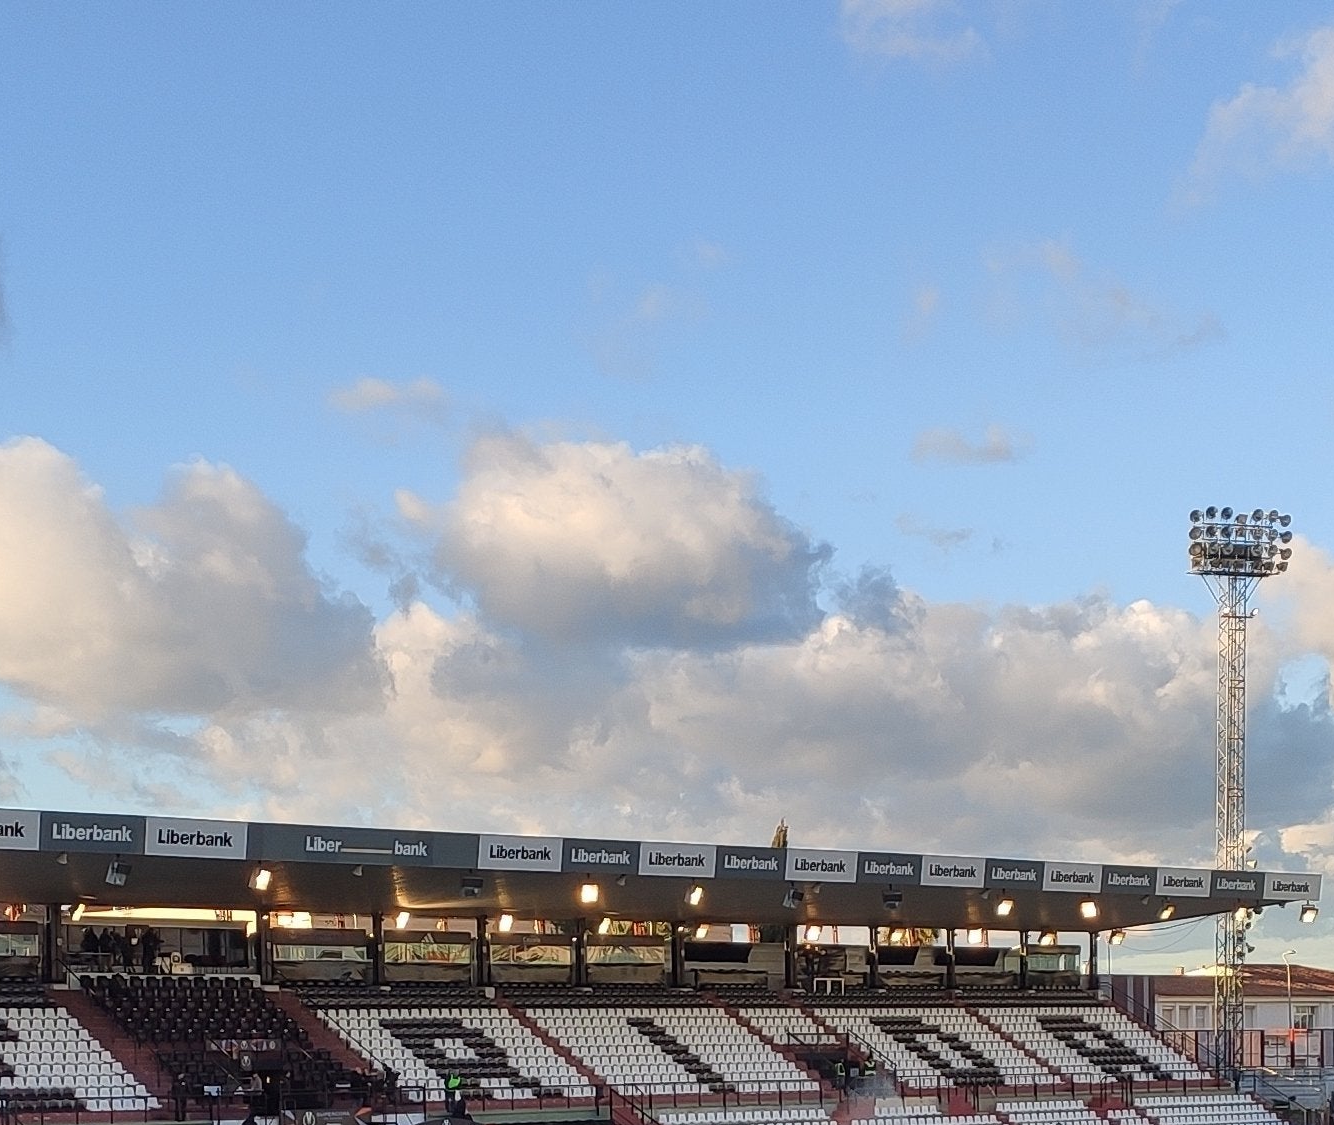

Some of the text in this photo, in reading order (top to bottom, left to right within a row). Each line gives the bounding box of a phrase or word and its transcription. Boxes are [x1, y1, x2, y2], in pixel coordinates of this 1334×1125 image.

[52, 823, 133, 844] Liberbank
[157, 828, 234, 849] Liberbank
[305, 835, 429, 857] Liber bank
[489, 844, 552, 863] Liberbank
[571, 848, 631, 867] Liberbank
[648, 850, 706, 869] Liberbank
[723, 853, 779, 872] Liberbank
[794, 858, 847, 875] Liberbank
[864, 861, 914, 878] Liberbank
[929, 864, 977, 881] Liberbank
[991, 866, 1038, 883] Liberbank
[1050, 869, 1095, 886] Liberbank
[1107, 872, 1150, 888] Liberbank
[1163, 875, 1204, 891] Liberbank
[1217, 877, 1256, 893] Liberbank
[1272, 880, 1310, 895] Liberbank
